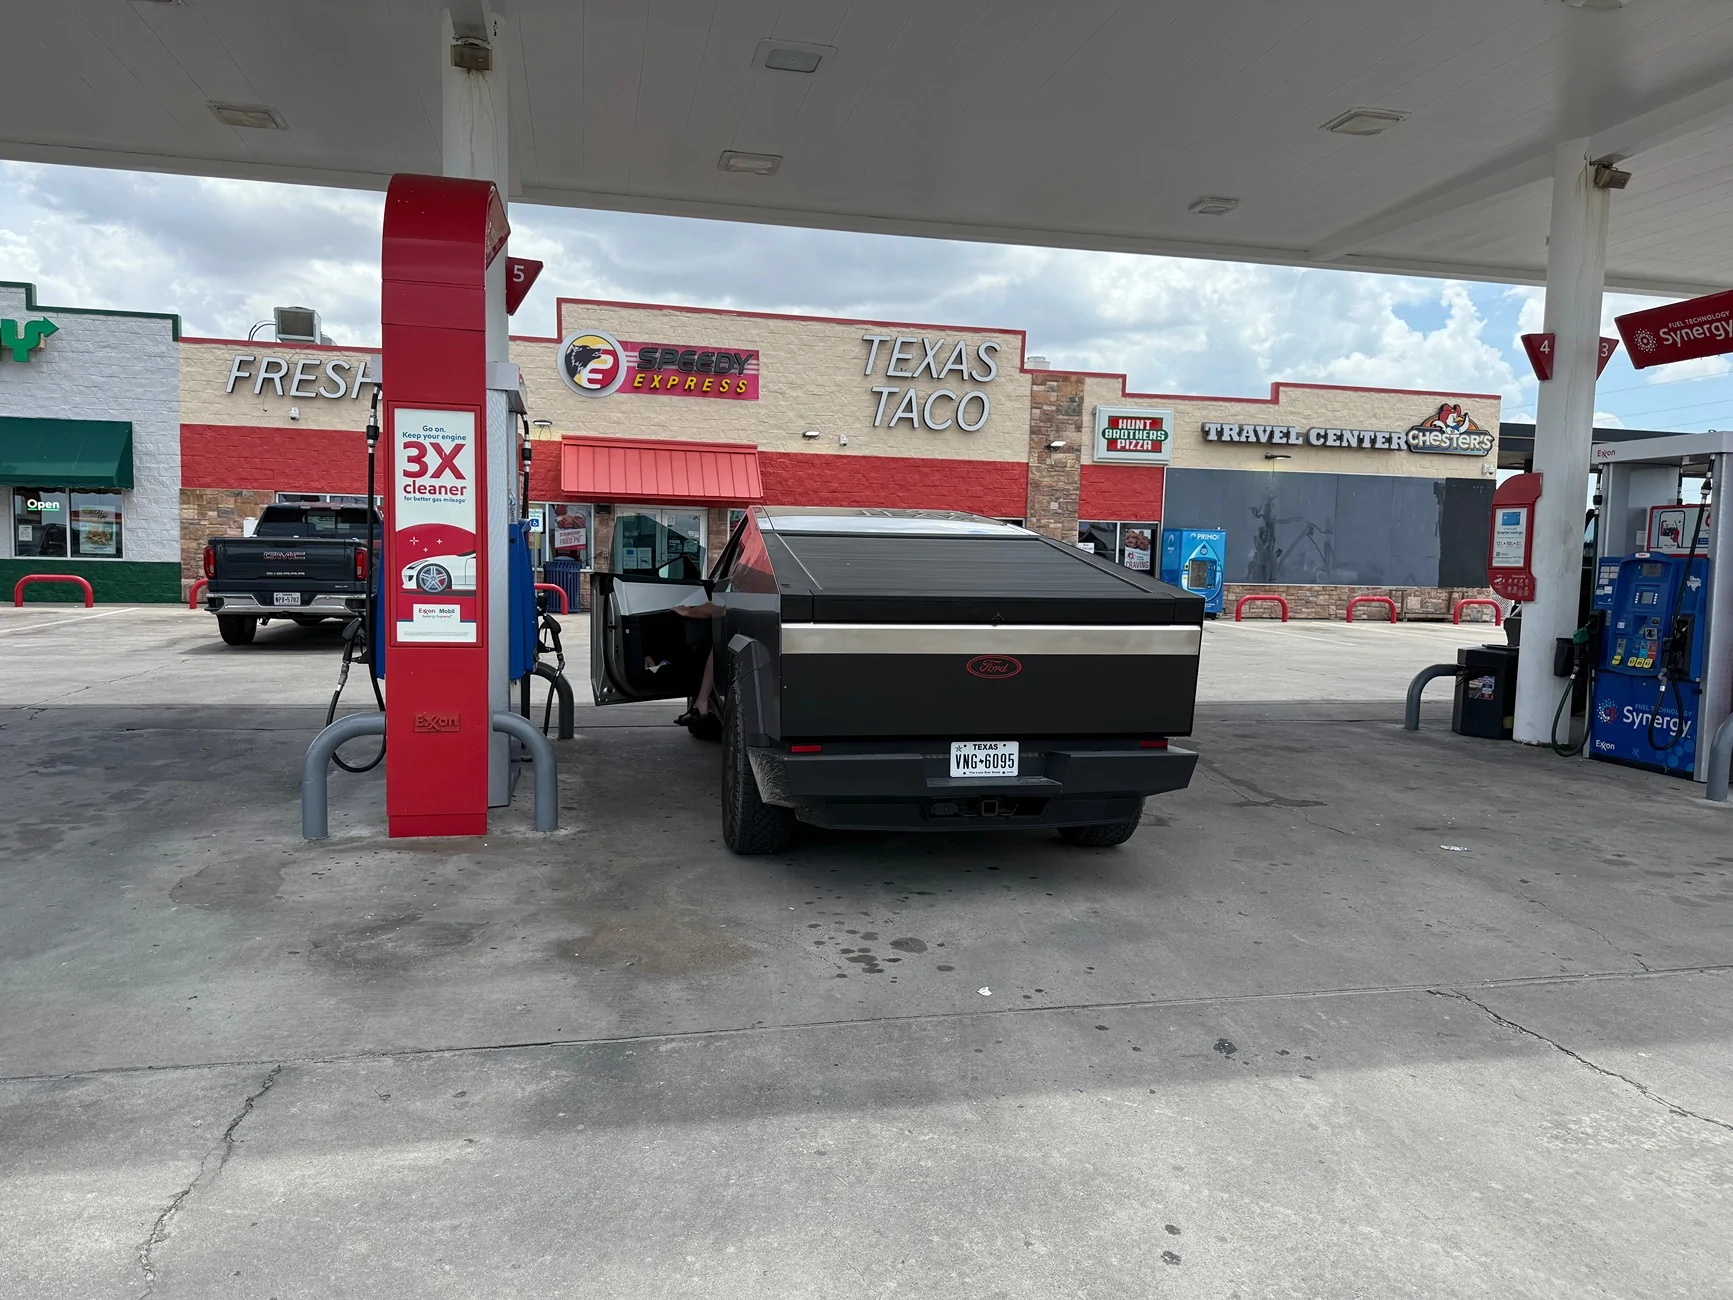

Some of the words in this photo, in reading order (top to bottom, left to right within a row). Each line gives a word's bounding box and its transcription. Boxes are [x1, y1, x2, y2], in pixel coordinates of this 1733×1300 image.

[513, 265, 525, 282] 5
[1668, 320, 1685, 328] FUEL
[1685, 310, 1730, 325] TECHNOLOGY
[1659, 319, 1733, 347] Synergy
[1540, 339, 1550, 354] 4
[1600, 342, 1609, 357] 3
[635, 347, 754, 376] SPEEDY
[862, 334, 1002, 382] TEXAS
[633, 373, 748, 394] EXPRESS
[871, 386, 990, 432] TACO
[1118, 419, 1152, 429] HUNT
[402, 432, 421, 440] Keep
[441, 434, 467, 442] engine
[1105, 429, 1165, 440] BROTHERS
[1204, 423, 1302, 445] TRAVEL
[1308, 427, 1407, 450] CENTER
[1117, 440, 1152, 450] PIZZA
[402, 440, 466, 480] 3X
[1597, 449, 1616, 459] Exxon
[403, 480, 467, 496] cleaner
[27, 499, 60, 511] Open
[979, 659, 1009, 673] Ford
[1635, 703, 1649, 711] FUEL
[1651, 705, 1692, 717] TCHNOLGY
[415, 714, 458, 731] Exxon
[1623, 706, 1692, 738] Synergy
[1595, 740, 1615, 751] Exxon
